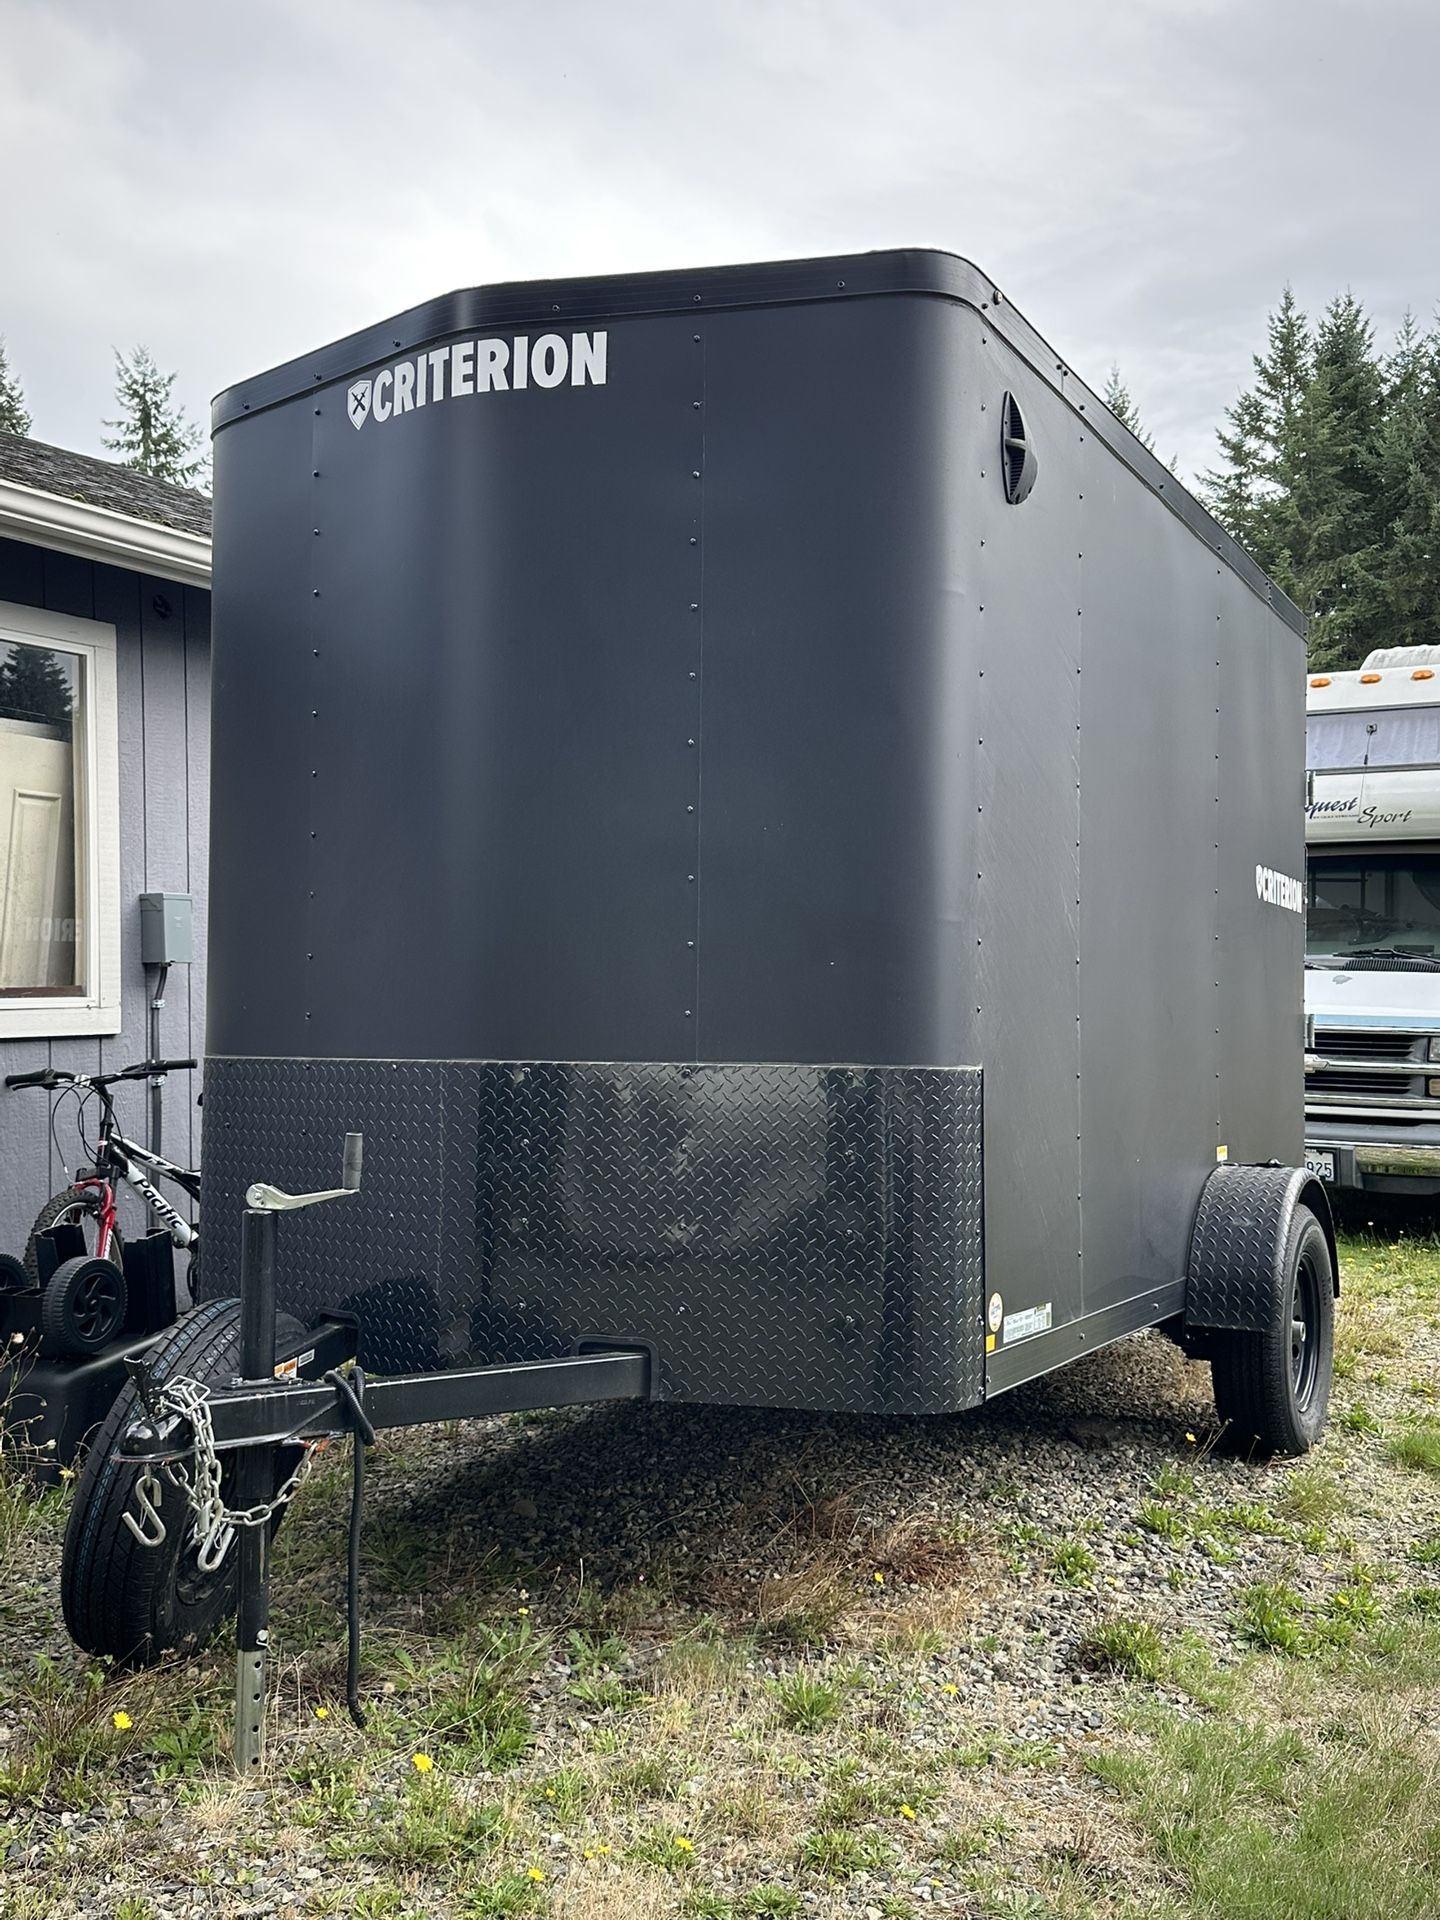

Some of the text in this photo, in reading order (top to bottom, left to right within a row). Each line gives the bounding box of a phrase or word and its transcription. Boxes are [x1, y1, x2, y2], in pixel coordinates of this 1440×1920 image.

[372, 331, 608, 423] CRITERION
[1357, 806, 1412, 829] Sport
[1262, 867, 1303, 914] CRITERION
[133, 1179, 183, 1229] Pacific
